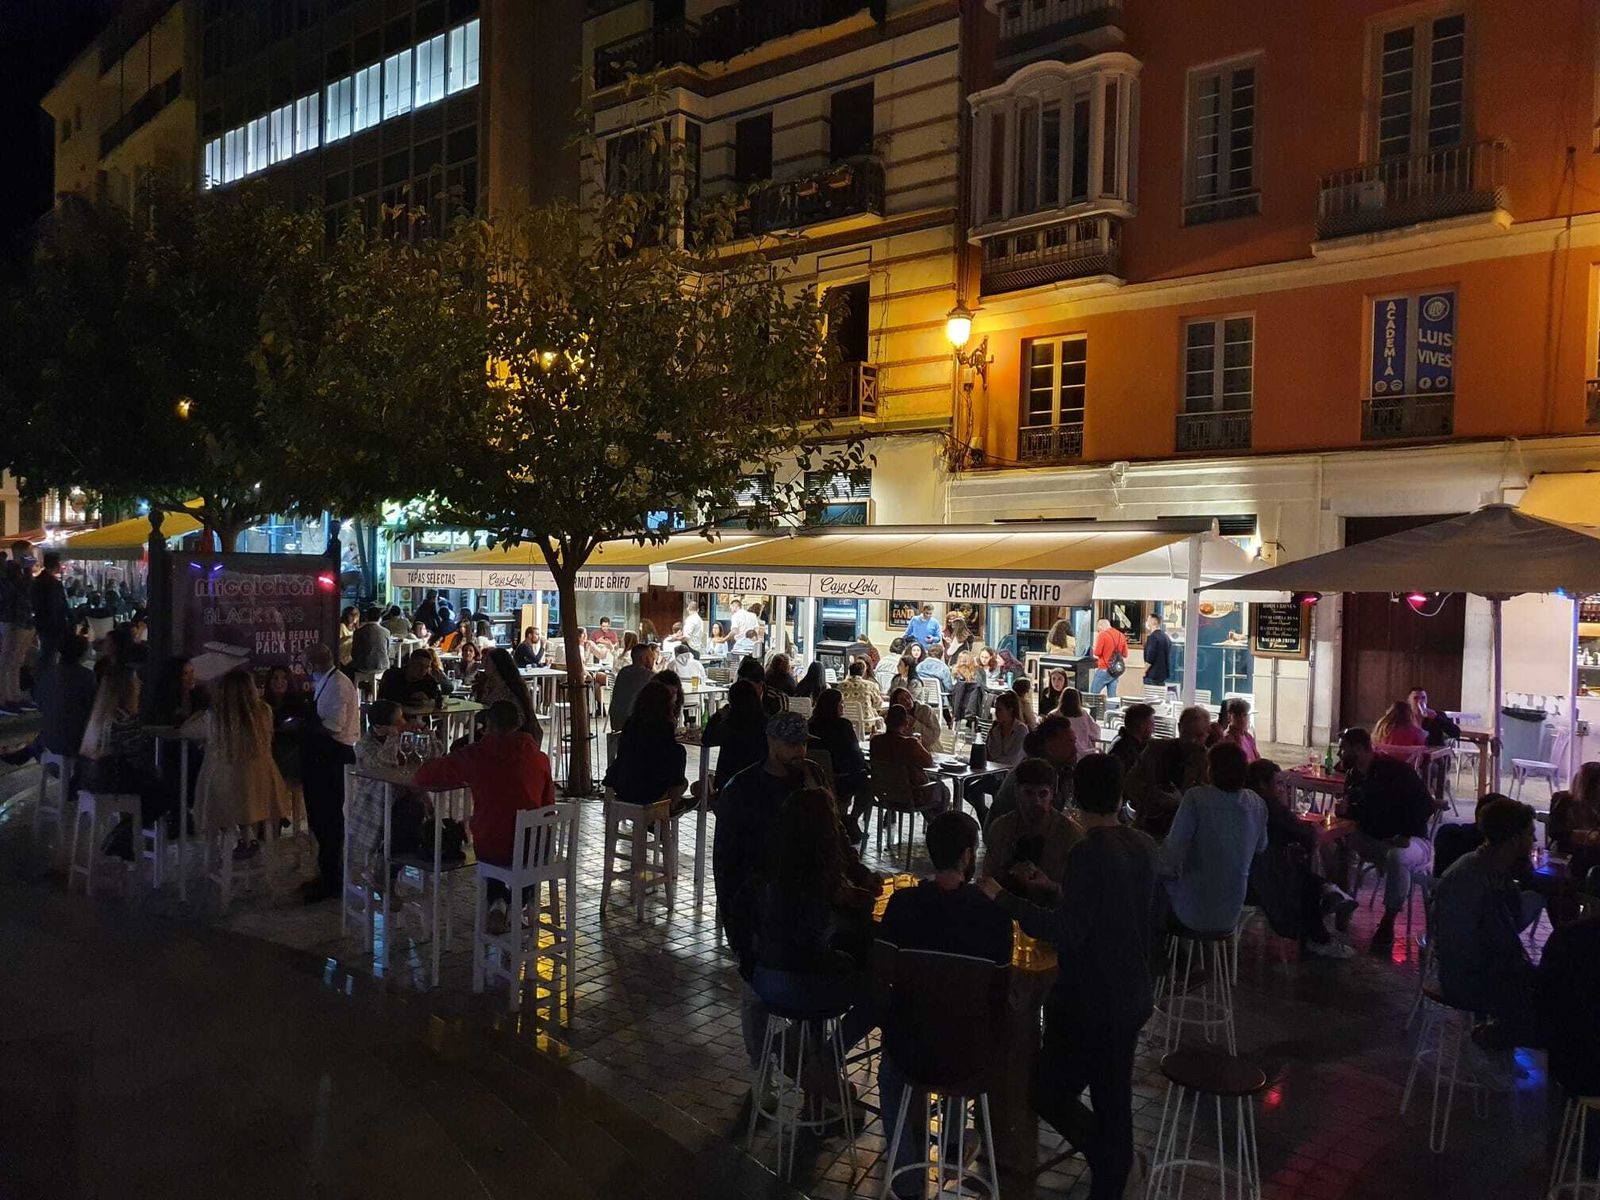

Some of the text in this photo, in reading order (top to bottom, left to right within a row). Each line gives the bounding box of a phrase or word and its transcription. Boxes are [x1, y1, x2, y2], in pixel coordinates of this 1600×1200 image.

[1384, 301, 1397, 376] ACADEMIA
[1419, 328, 1453, 347] LUIS
[1417, 349, 1452, 368] VIVES
[408, 572, 456, 586] TAPAS SELECTAS
[489, 572, 526, 588] Casa Lola
[594, 576, 605, 589] DE
[606, 576, 630, 590] GRIFO
[692, 575, 767, 592] TAPAS SELECTAS
[821, 577, 880, 595] Casa Lola
[947, 582, 1061, 602] VERMUT DE GRIFO
[255, 629, 320, 641] OFERTA REGALO
[255, 640, 286, 655] PACK
